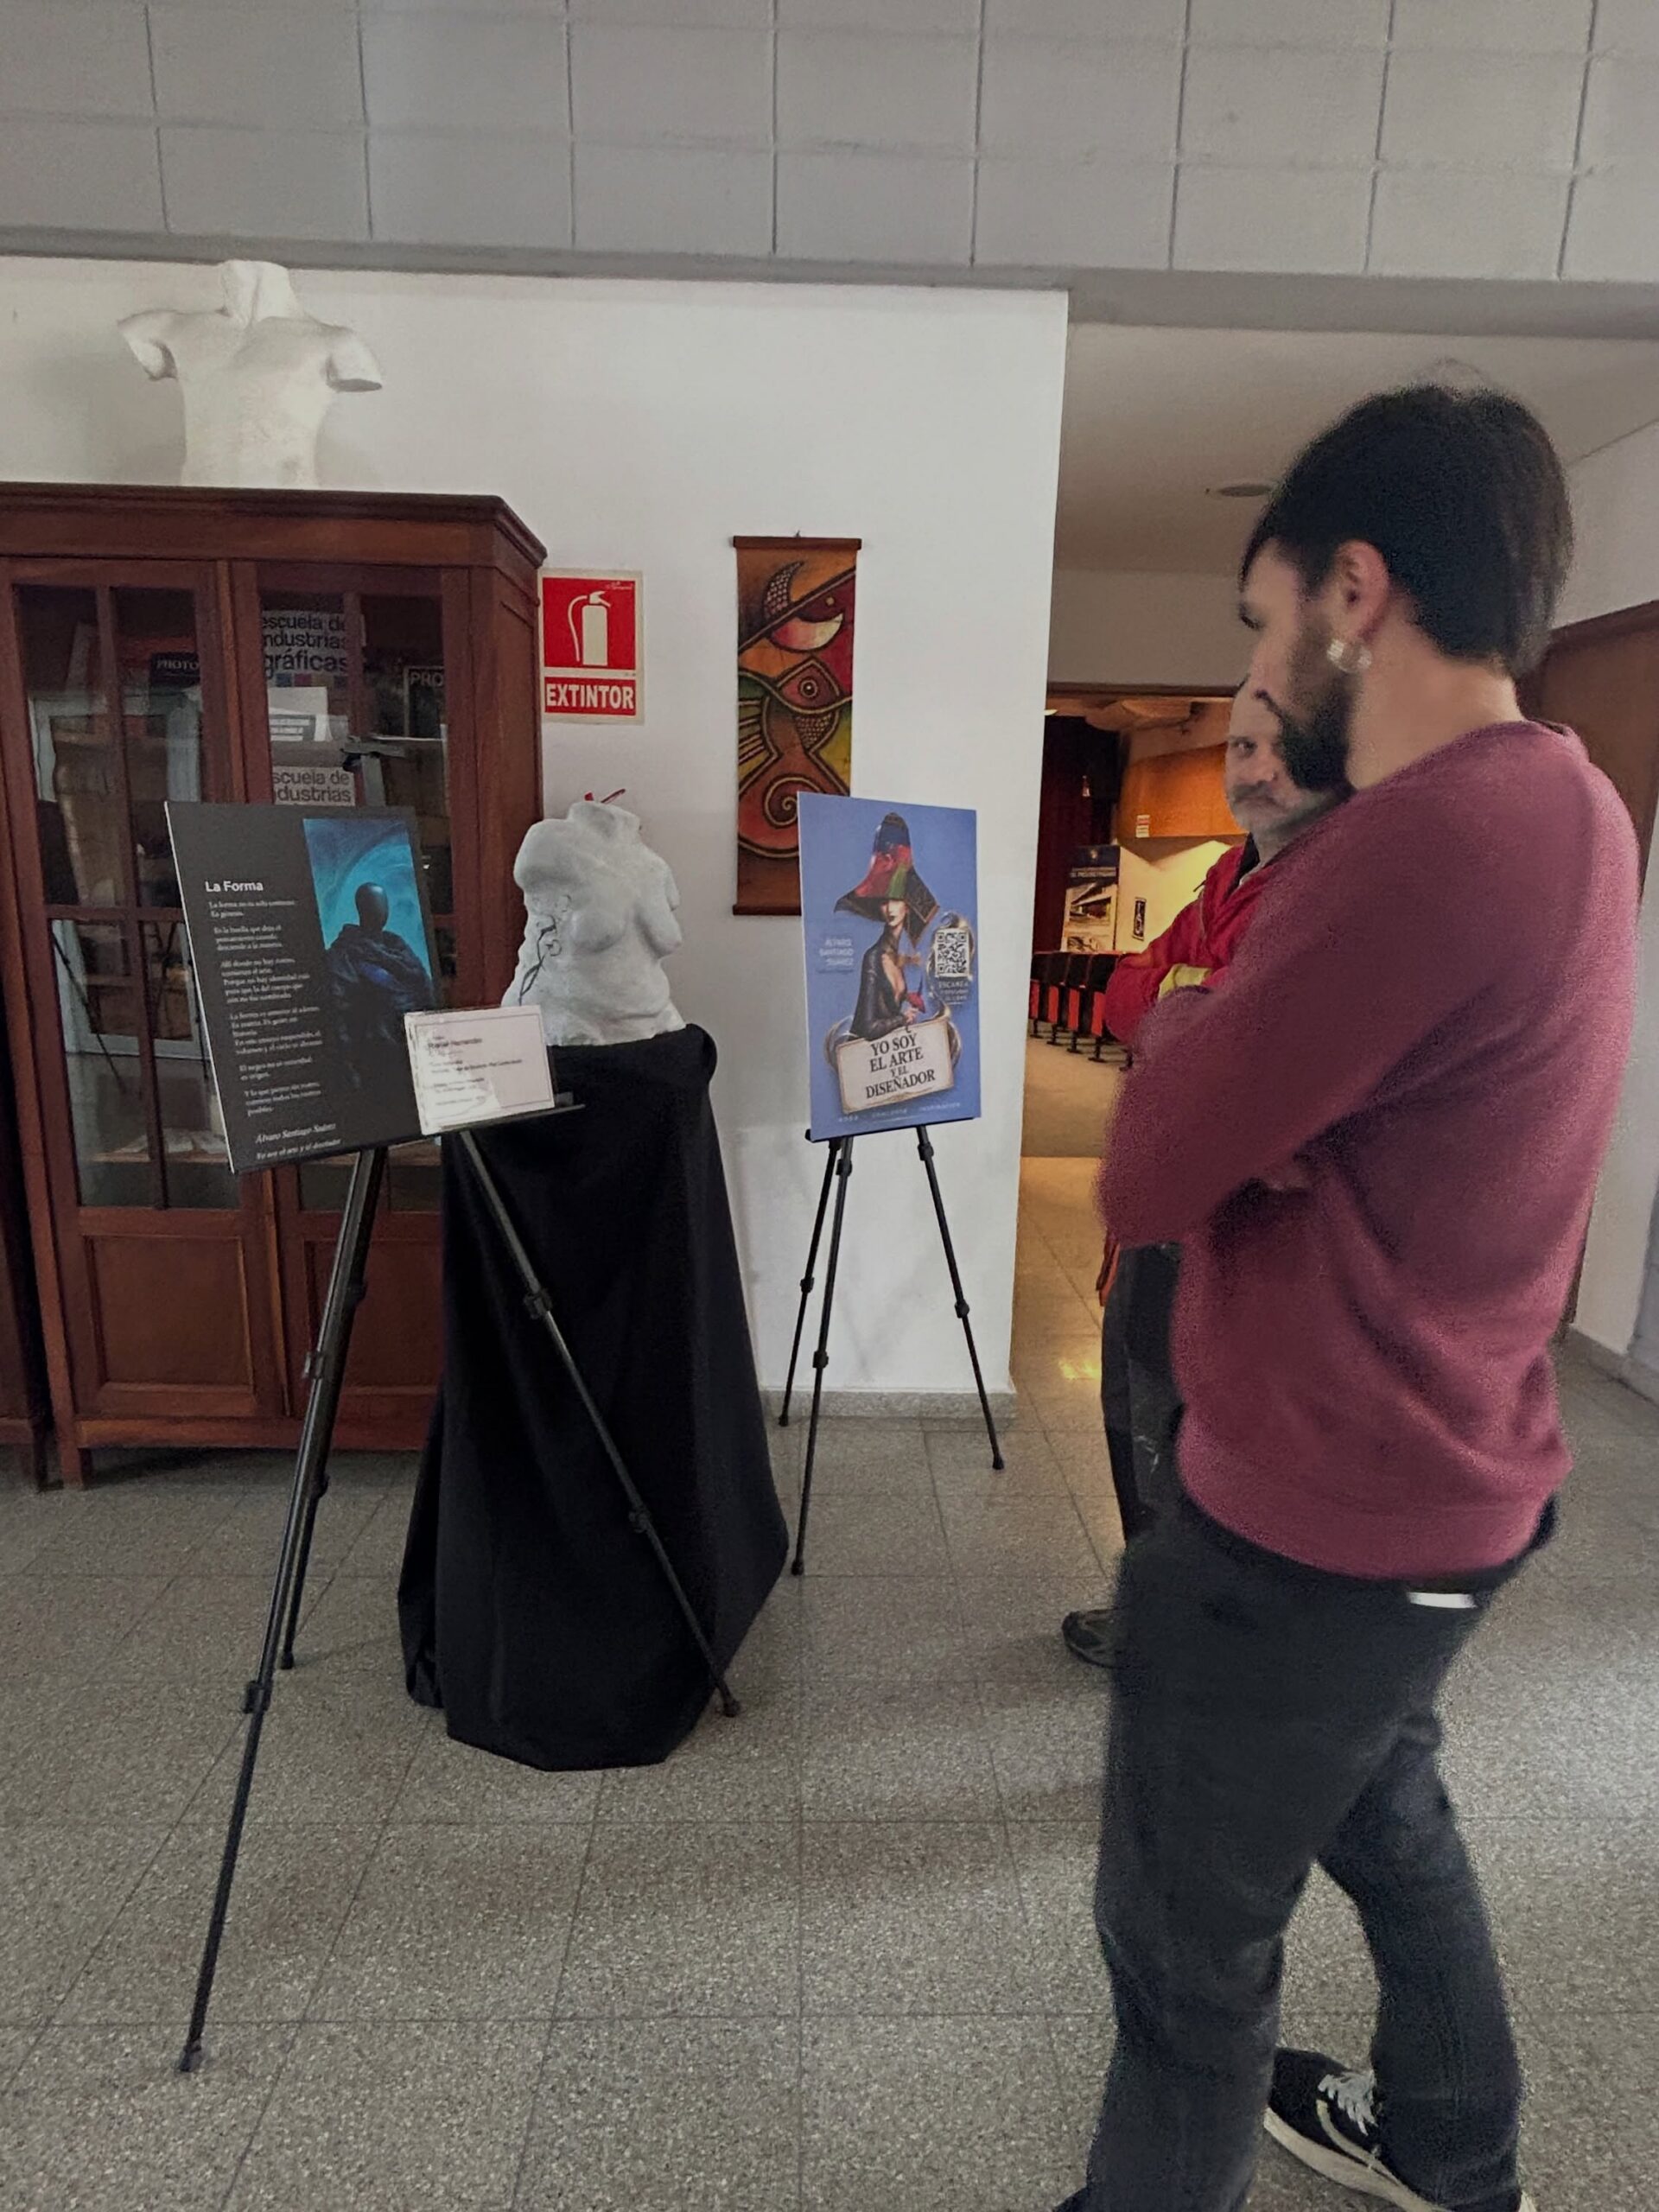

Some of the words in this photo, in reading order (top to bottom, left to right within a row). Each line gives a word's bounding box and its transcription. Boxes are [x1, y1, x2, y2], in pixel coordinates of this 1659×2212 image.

[545, 683, 634, 709] EXTINTOR
[272, 770, 326, 785] scuela
[330, 770, 350, 785] de
[276, 785, 351, 802] dustrias
[205, 880, 221, 892] La
[223, 880, 264, 892] Forma
[871, 1040, 889, 1056] YO
[893, 1033, 918, 1052] SOY
[870, 1056, 887, 1073] EL
[889, 1046, 924, 1068] ARTE
[890, 1067, 897, 1077] Y
[898, 1065, 909, 1076] EL
[866, 1069, 936, 1099] DISEÑADOR
